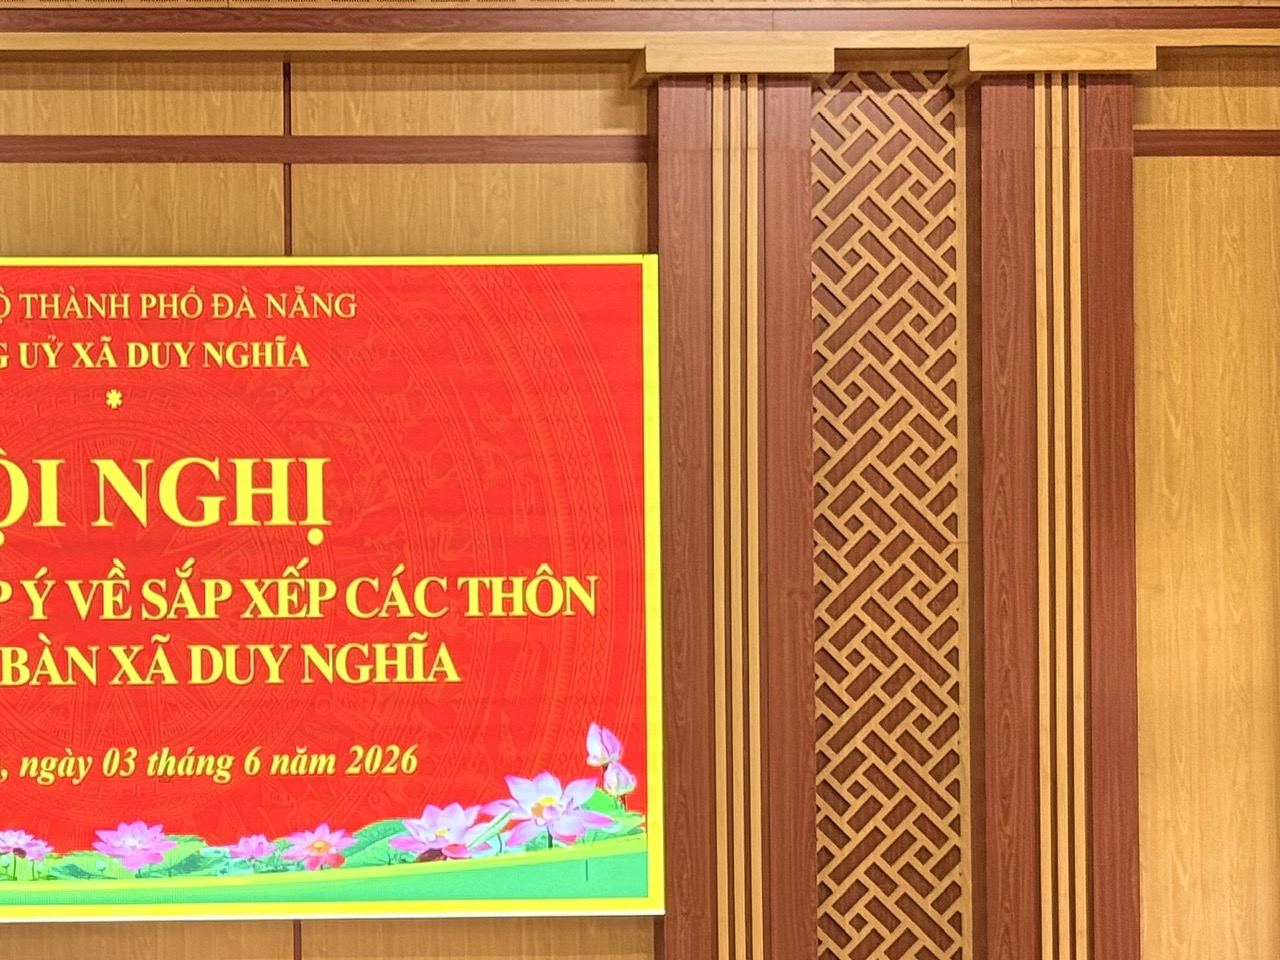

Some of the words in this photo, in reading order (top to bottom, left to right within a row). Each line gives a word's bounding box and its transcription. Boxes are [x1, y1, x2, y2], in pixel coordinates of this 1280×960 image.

[20, 287, 129, 318] THÀNH
[141, 287, 202, 318] PHỐ
[212, 287, 255, 317] ĐÀ
[266, 287, 356, 317] NẴNG
[20, 336, 62, 368] UỶ
[73, 337, 117, 367] XÃ
[128, 343, 194, 367] DUY
[204, 336, 308, 367] NGHĨA
[91, 458, 331, 545] NGHỊ
[20, 567, 55, 619] Ý
[65, 559, 131, 619] VỀ
[142, 558, 232, 619] SẮP
[241, 558, 336, 618] XẾP
[346, 564, 447, 618] CÁC
[458, 564, 597, 616] THÔN
[0, 633, 99, 685] BÀN
[109, 634, 178, 684] XÃ
[188, 645, 291, 684] DUY
[301, 632, 461, 683] NGHĨA
[20, 748, 92, 784] ngày
[103, 748, 137, 776] 03
[147, 747, 234, 783] tháng
[245, 747, 260, 774] 6
[271, 747, 335, 774] năm
[346, 745, 417, 773] 2026
